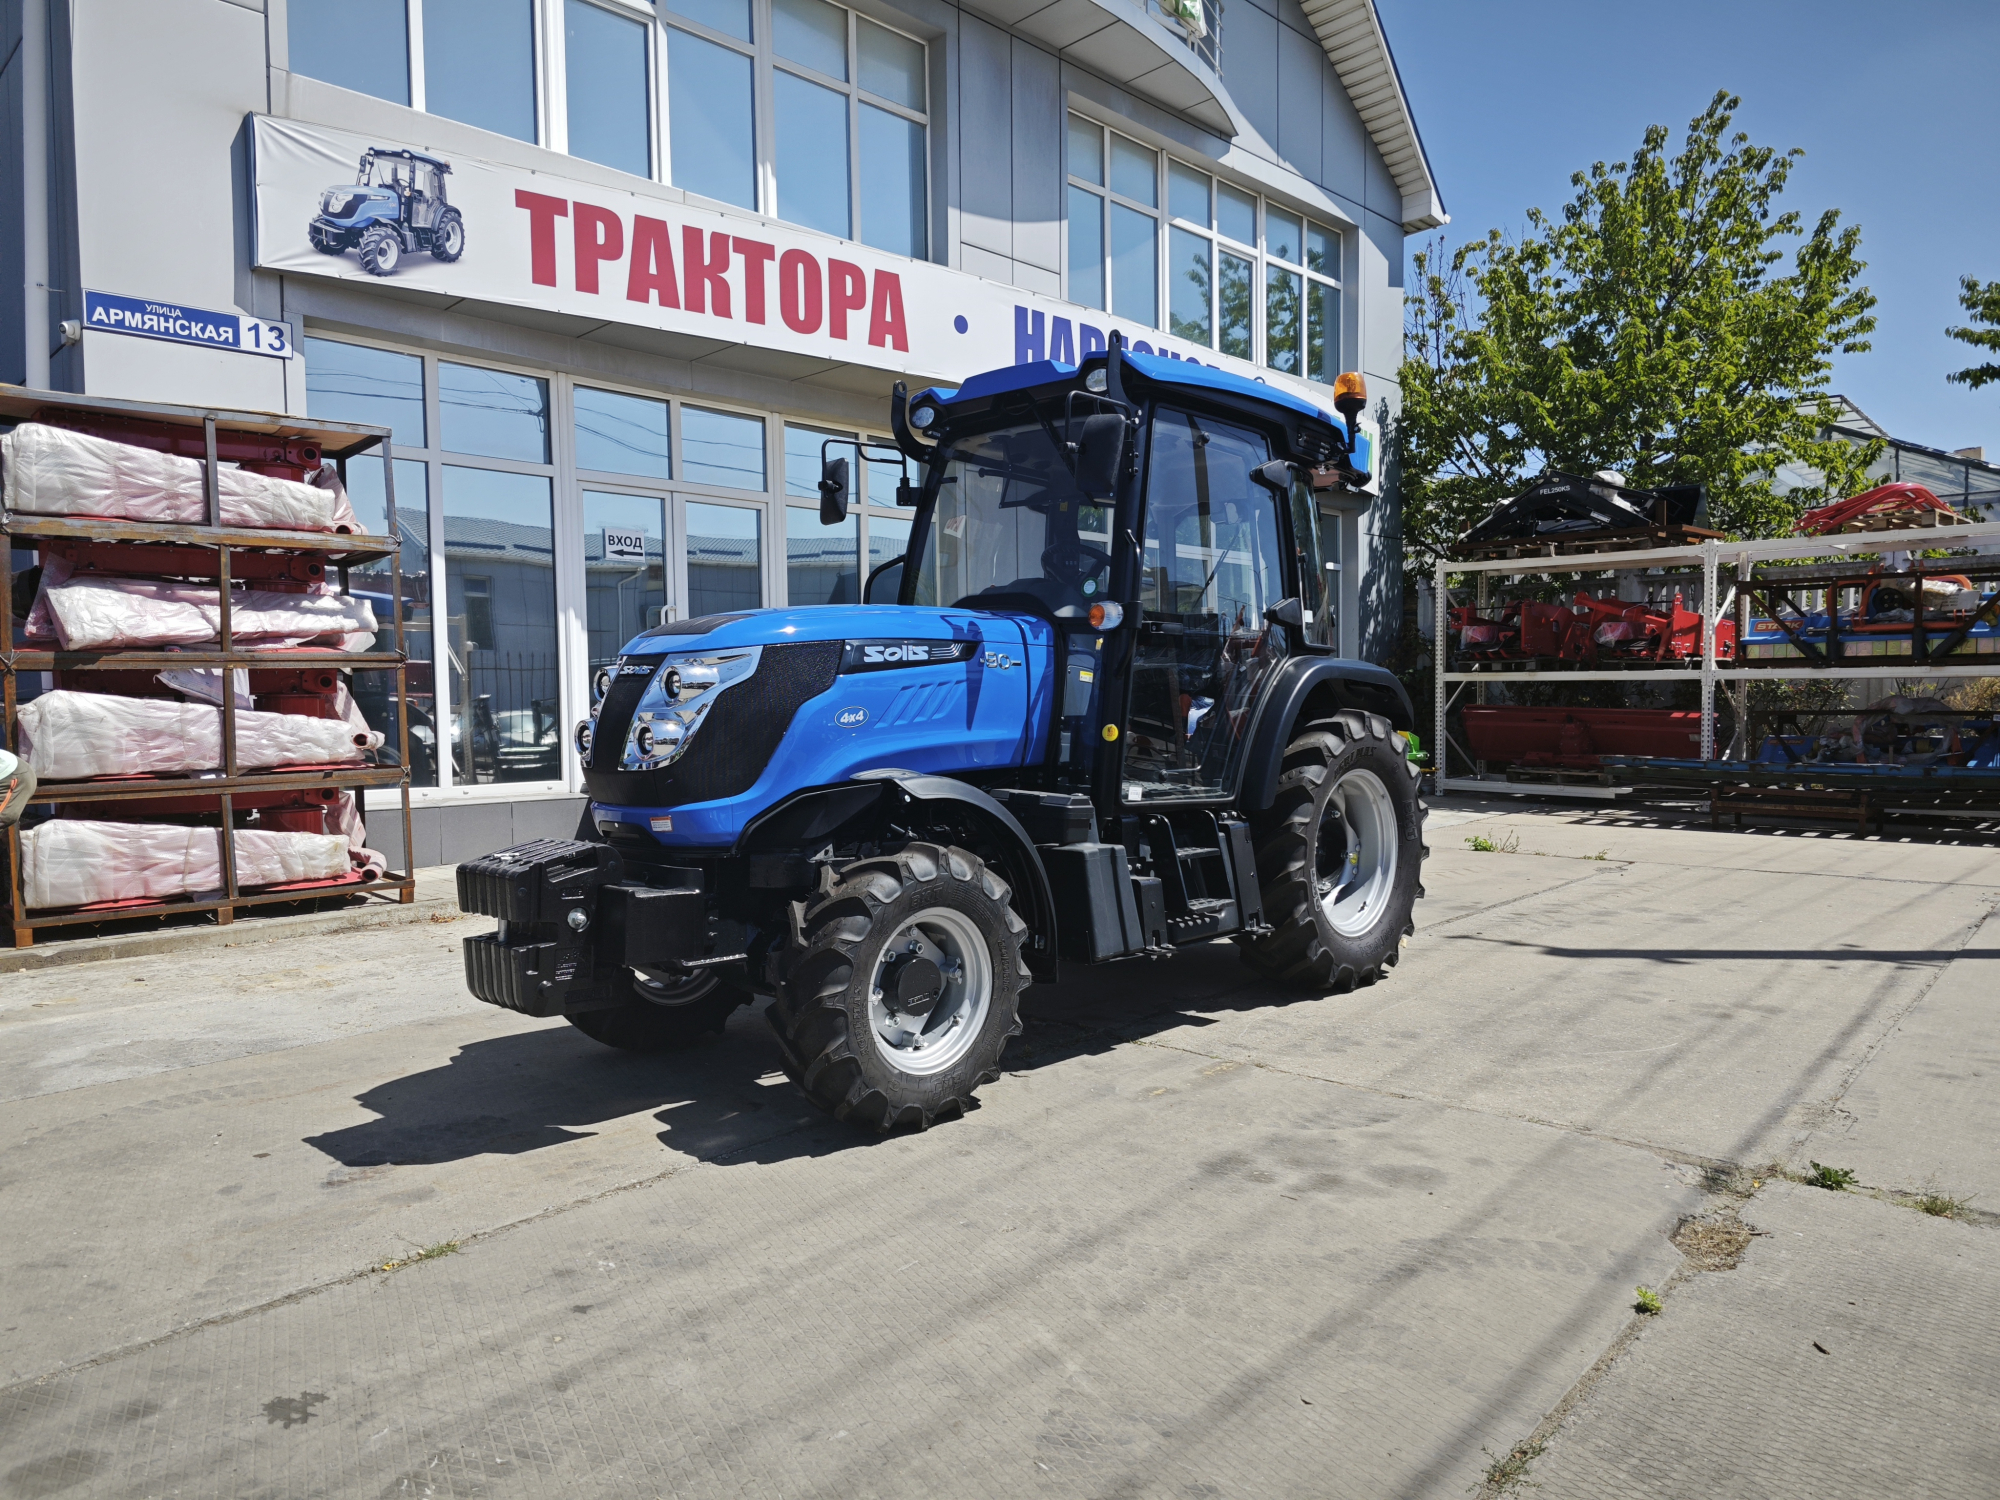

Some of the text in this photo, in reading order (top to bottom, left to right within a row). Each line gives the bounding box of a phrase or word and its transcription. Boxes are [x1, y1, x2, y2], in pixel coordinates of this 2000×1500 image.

[514, 188, 910, 354] ТРАКТОРА
[144, 303, 183, 318] УЛИЦА
[91, 306, 286, 352] АРМЯНСКАЯ 13
[1539, 485, 1571, 496] FEL250KS
[608, 534, 643, 550] ВХОД
